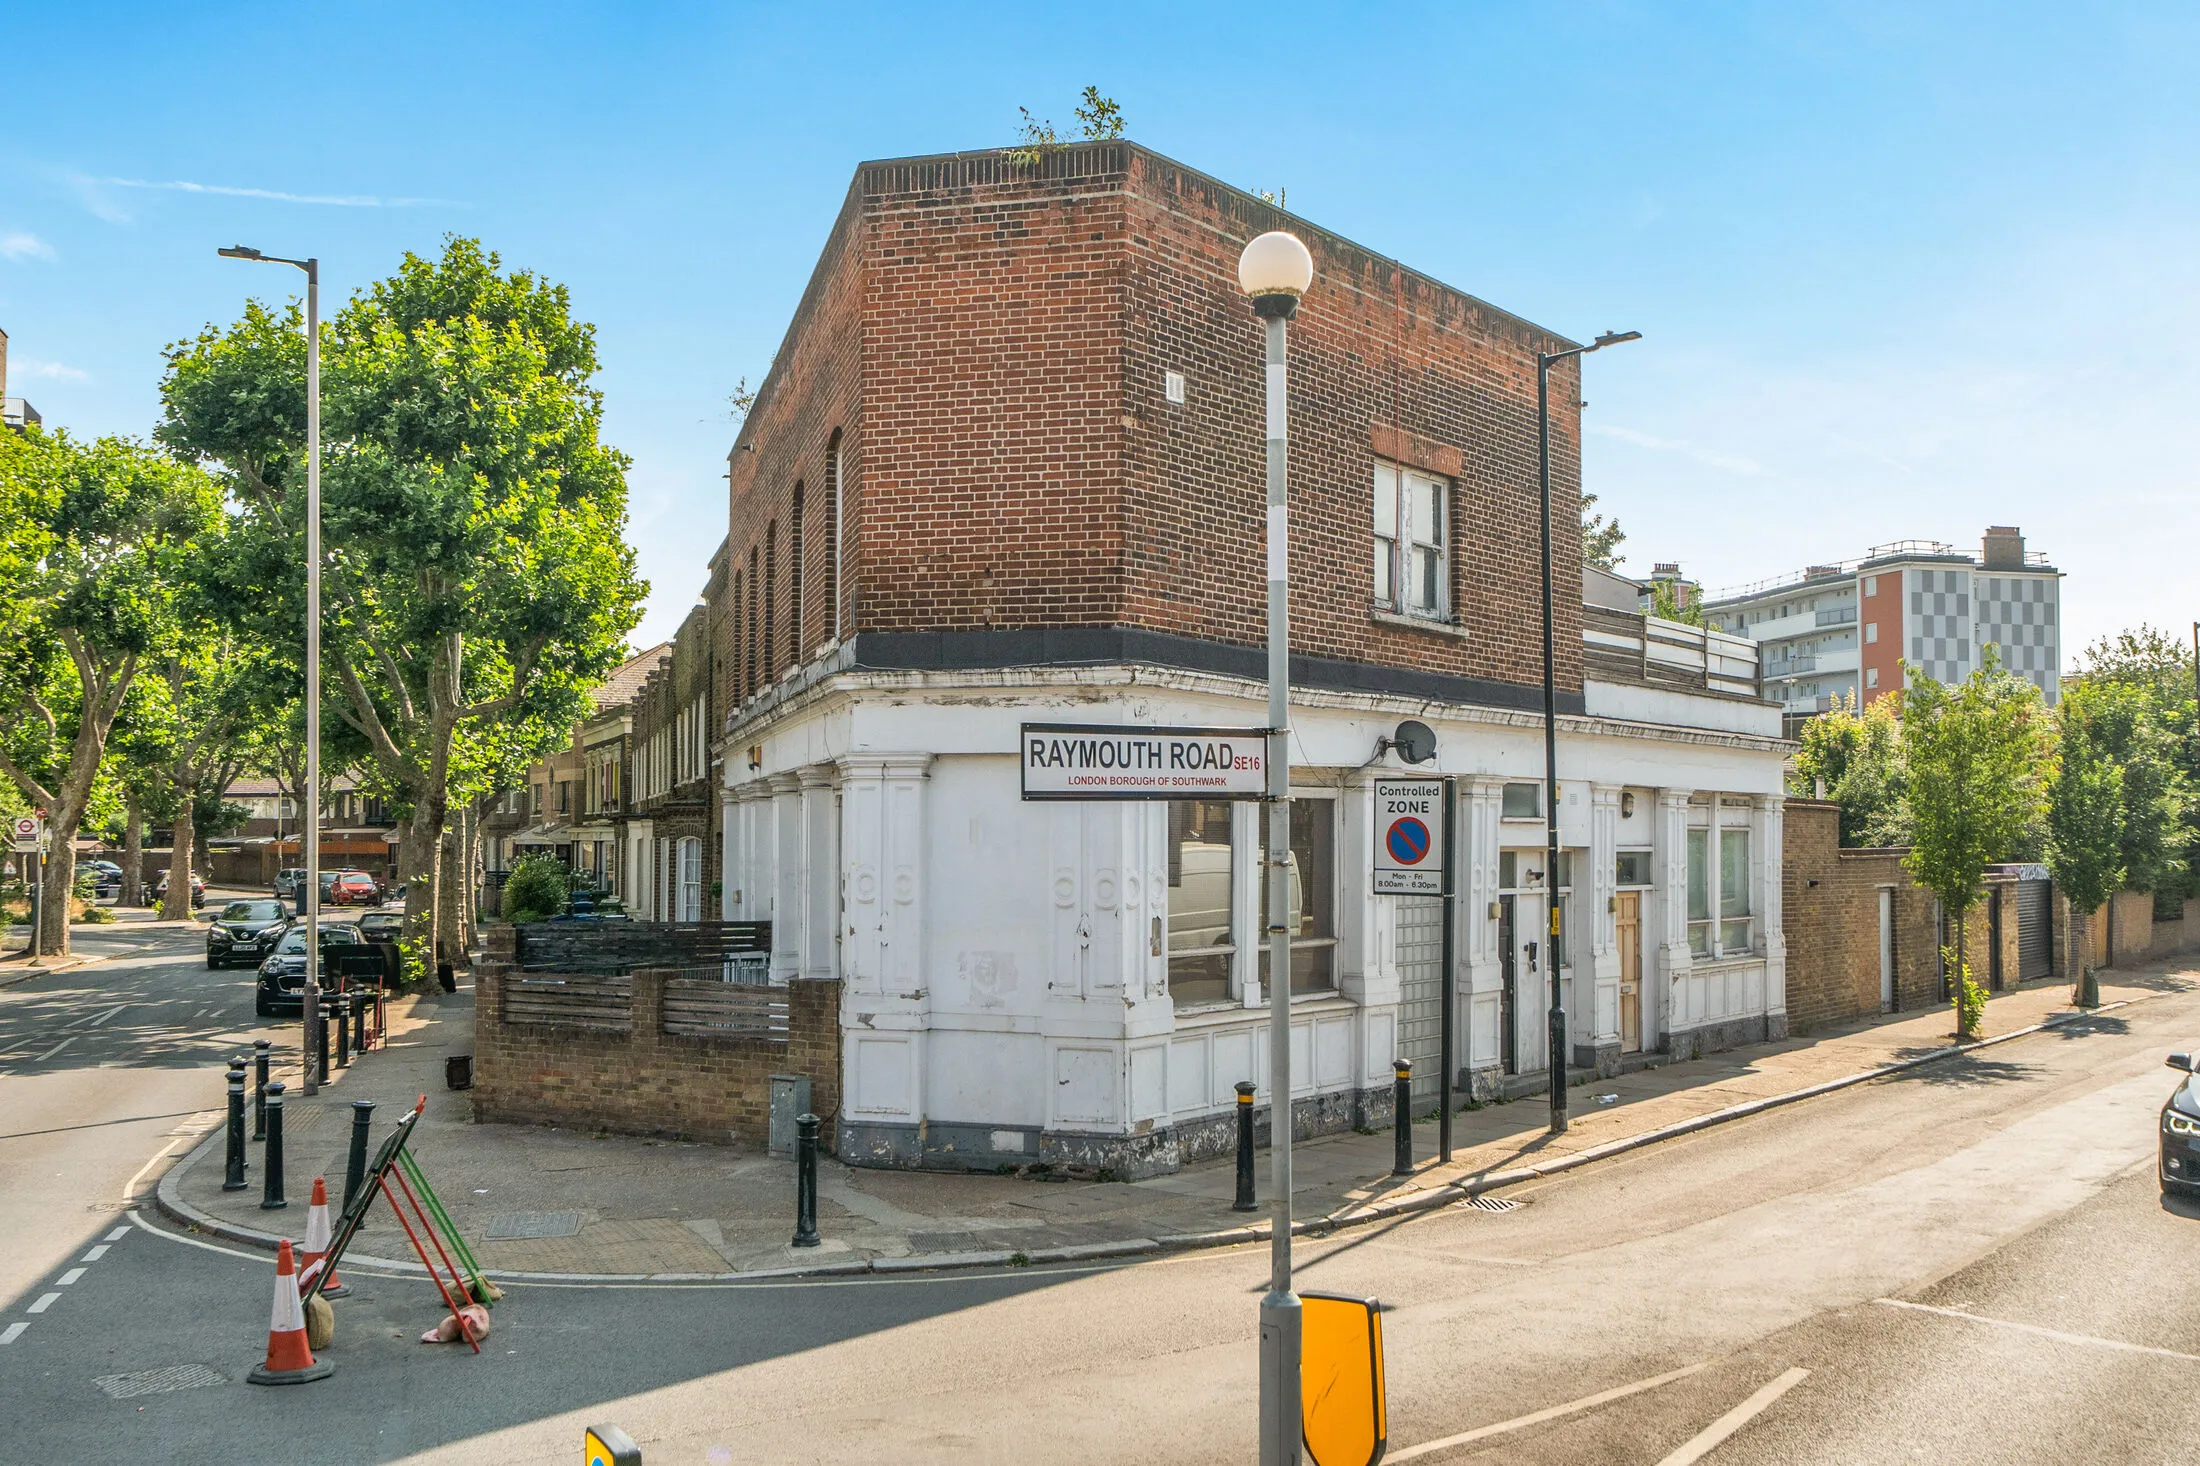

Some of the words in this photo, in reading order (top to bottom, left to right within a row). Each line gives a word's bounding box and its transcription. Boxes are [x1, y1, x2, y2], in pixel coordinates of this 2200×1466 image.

[1030, 739, 1162, 769] RAYMOUTH
[1170, 742, 1233, 770] ROAD
[1233, 756, 1260, 770] SE16
[1068, 776, 1107, 785] LONDON
[1110, 776, 1157, 786] BOROUGH
[1158, 777, 1170, 786] OF
[1172, 777, 1227, 786] SOUTHWARK
[1379, 785, 1440, 796] Controlled
[1387, 801, 1430, 813] ZONE
